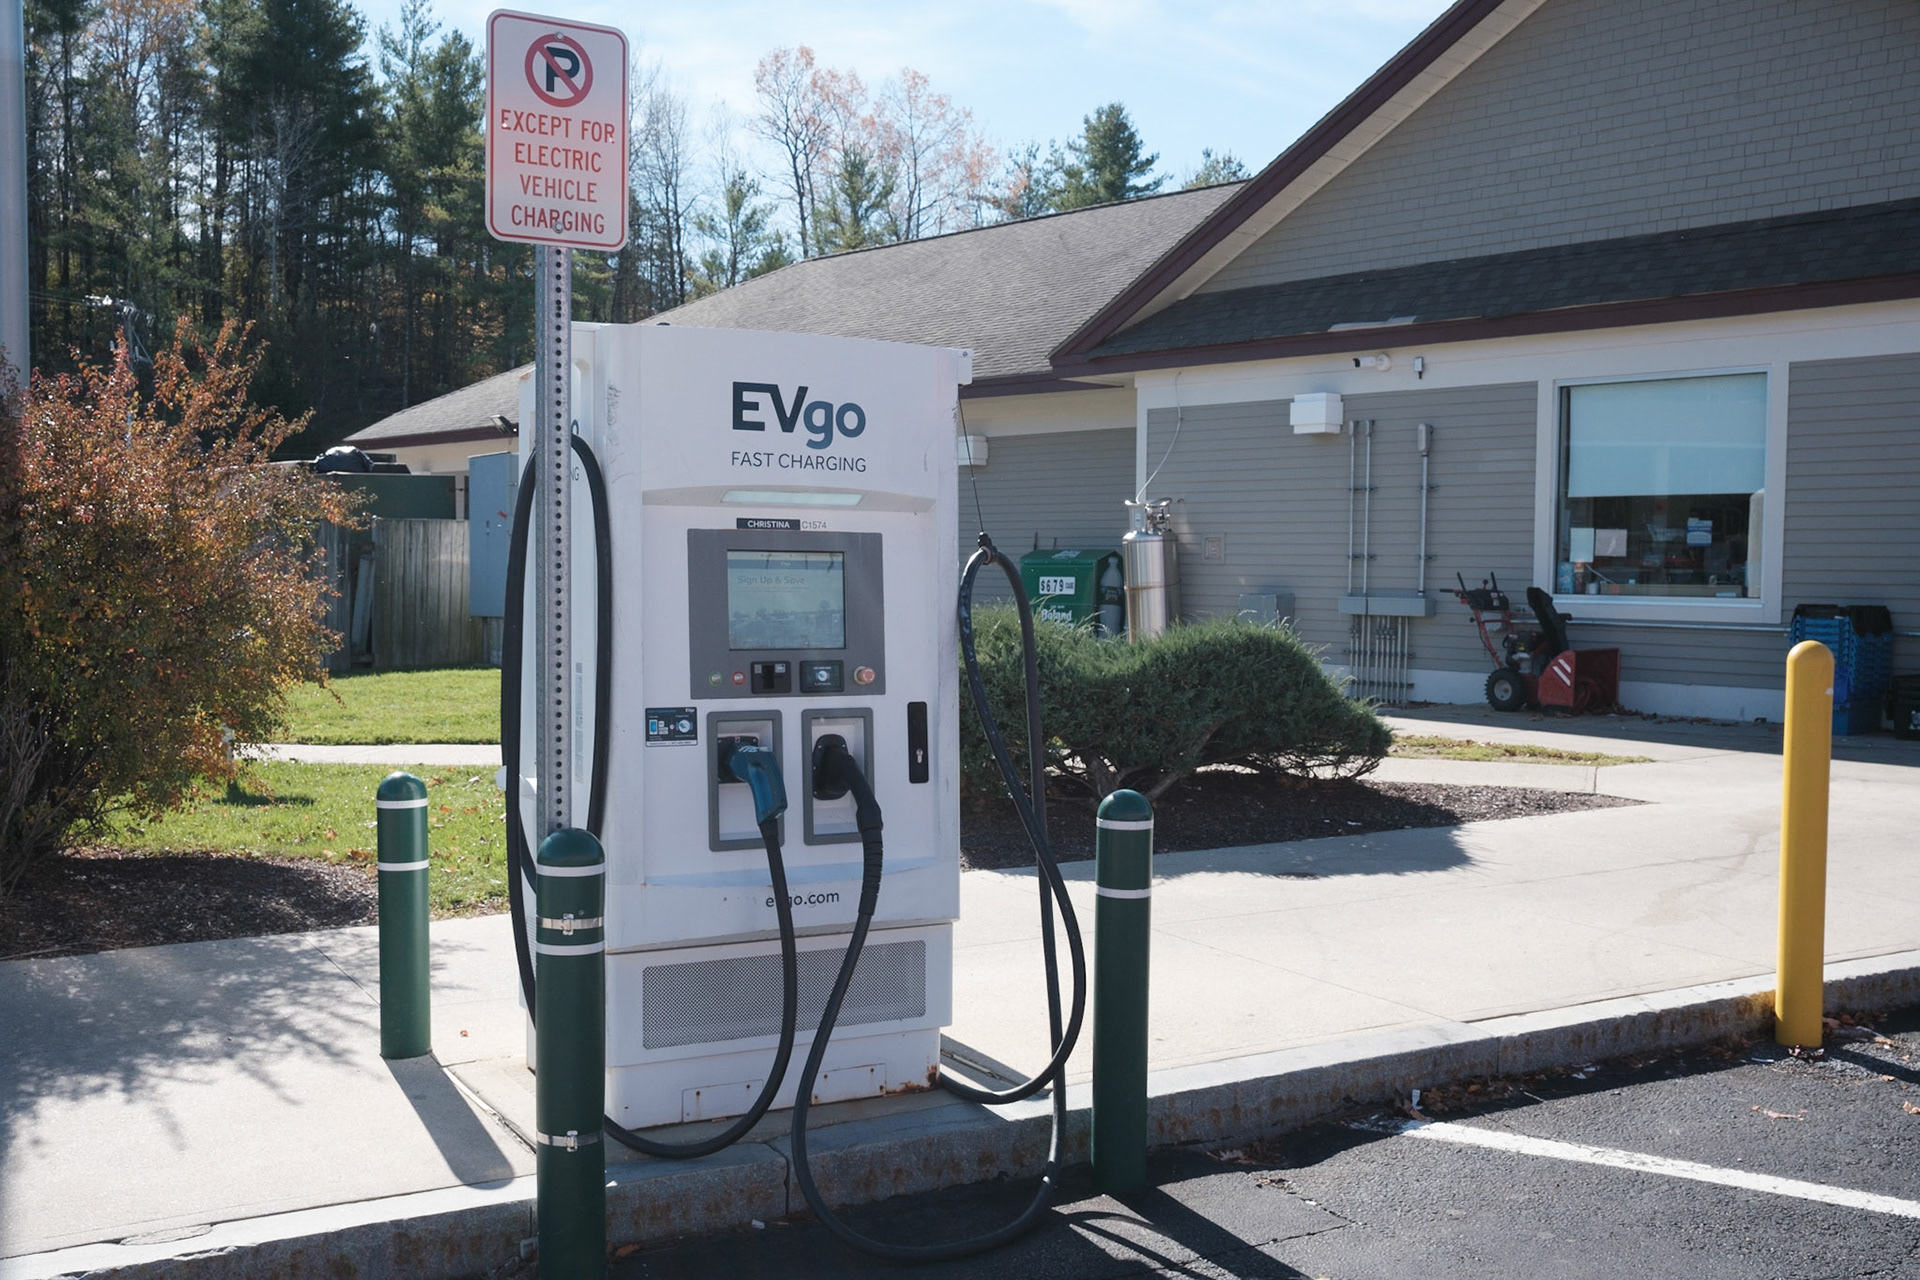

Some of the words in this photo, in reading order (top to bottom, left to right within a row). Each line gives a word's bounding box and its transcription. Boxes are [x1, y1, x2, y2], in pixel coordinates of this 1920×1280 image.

[501, 108, 572, 138] EXCEPT
[581, 120, 615, 144] FOR
[515, 142, 602, 173] ELECTRIC
[520, 174, 597, 203] VEHICLE
[511, 204, 605, 234] CHARGING
[732, 381, 867, 450] EVgo
[731, 451, 774, 468] FAST
[778, 453, 867, 473] CHARGING
[747, 519, 791, 529] CHRISTINA
[801, 520, 827, 530] C1574
[737, 575, 758, 586] Sign
[760, 576, 773, 586] Up
[774, 576, 781, 584] &
[783, 576, 806, 585] Save
